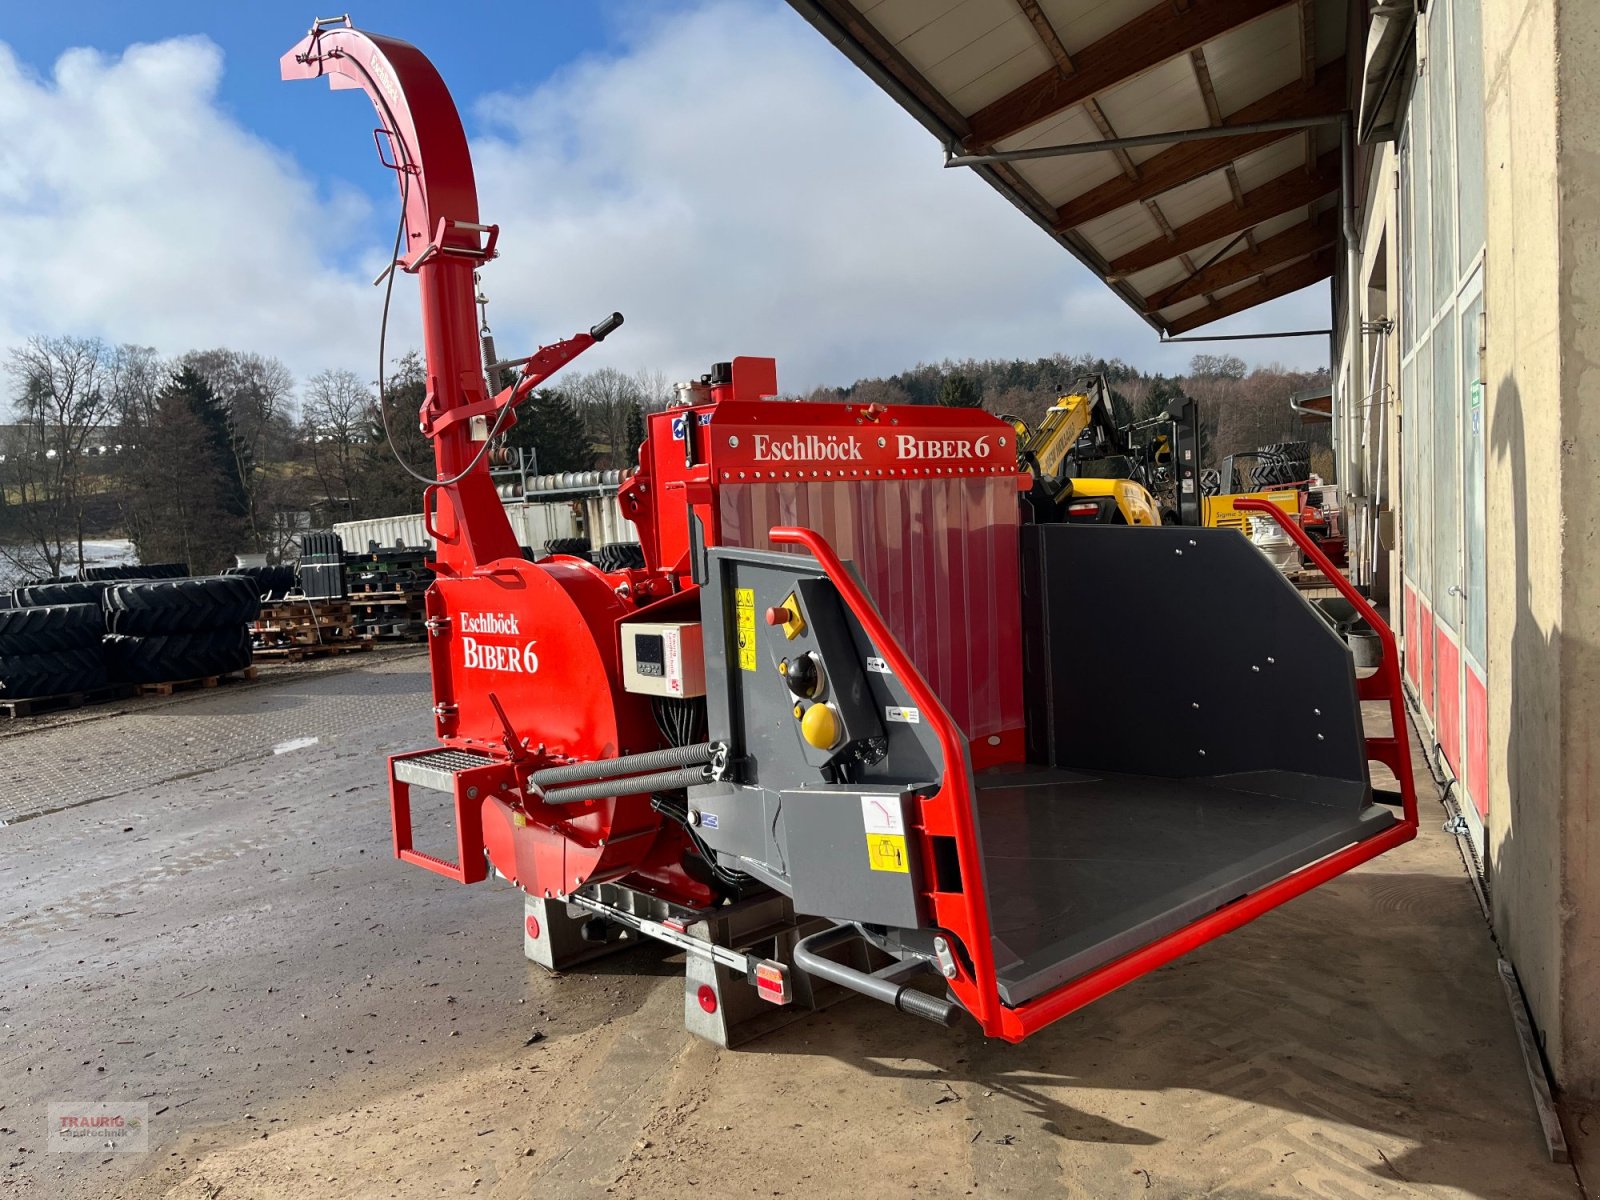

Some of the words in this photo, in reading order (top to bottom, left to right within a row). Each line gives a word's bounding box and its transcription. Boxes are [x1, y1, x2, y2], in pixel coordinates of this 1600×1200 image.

[752, 434, 863, 461] Eschlböck
[974, 435, 990, 458] 6
[460, 611, 520, 635] Eschlböck
[523, 640, 539, 674] 6
